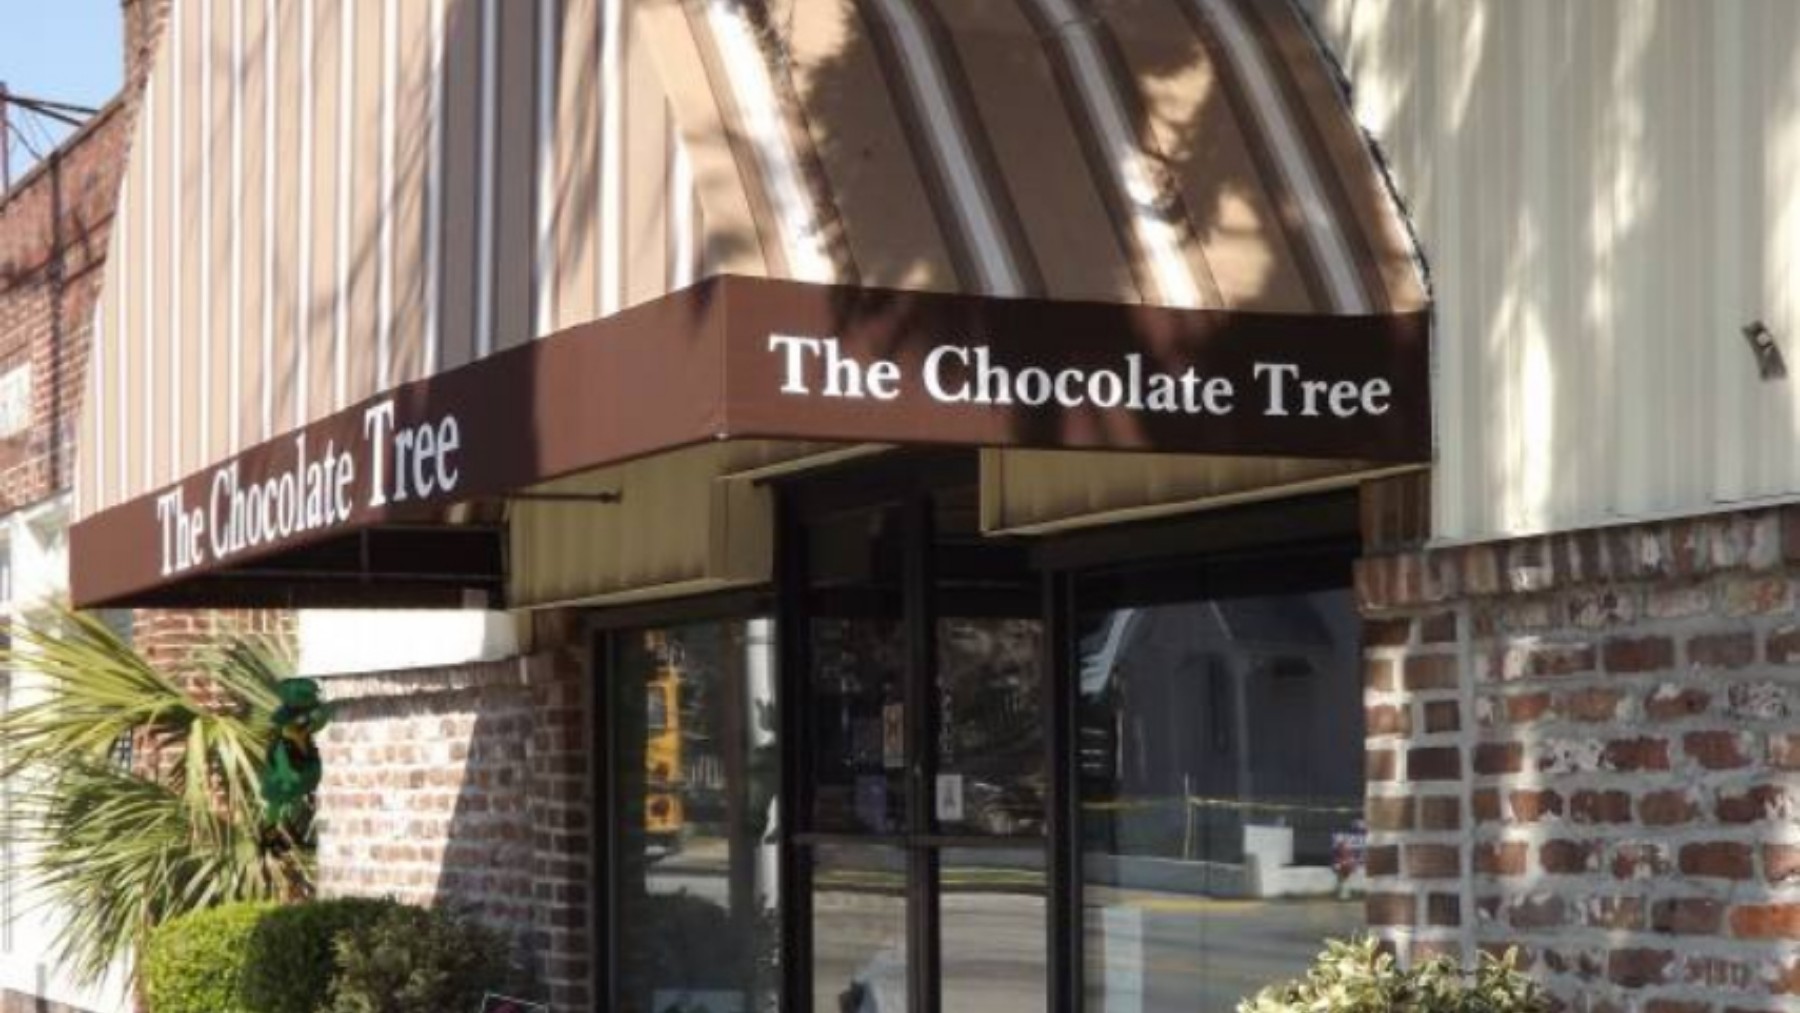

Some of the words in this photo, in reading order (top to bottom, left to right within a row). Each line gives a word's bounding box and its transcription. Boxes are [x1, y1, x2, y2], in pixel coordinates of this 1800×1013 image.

[767, 335, 901, 399] The
[923, 345, 1234, 415] Chocolate
[1253, 362, 1392, 416] Tree
[157, 485, 205, 577] The
[210, 432, 355, 560] Chocolate
[364, 400, 460, 508] Tree
